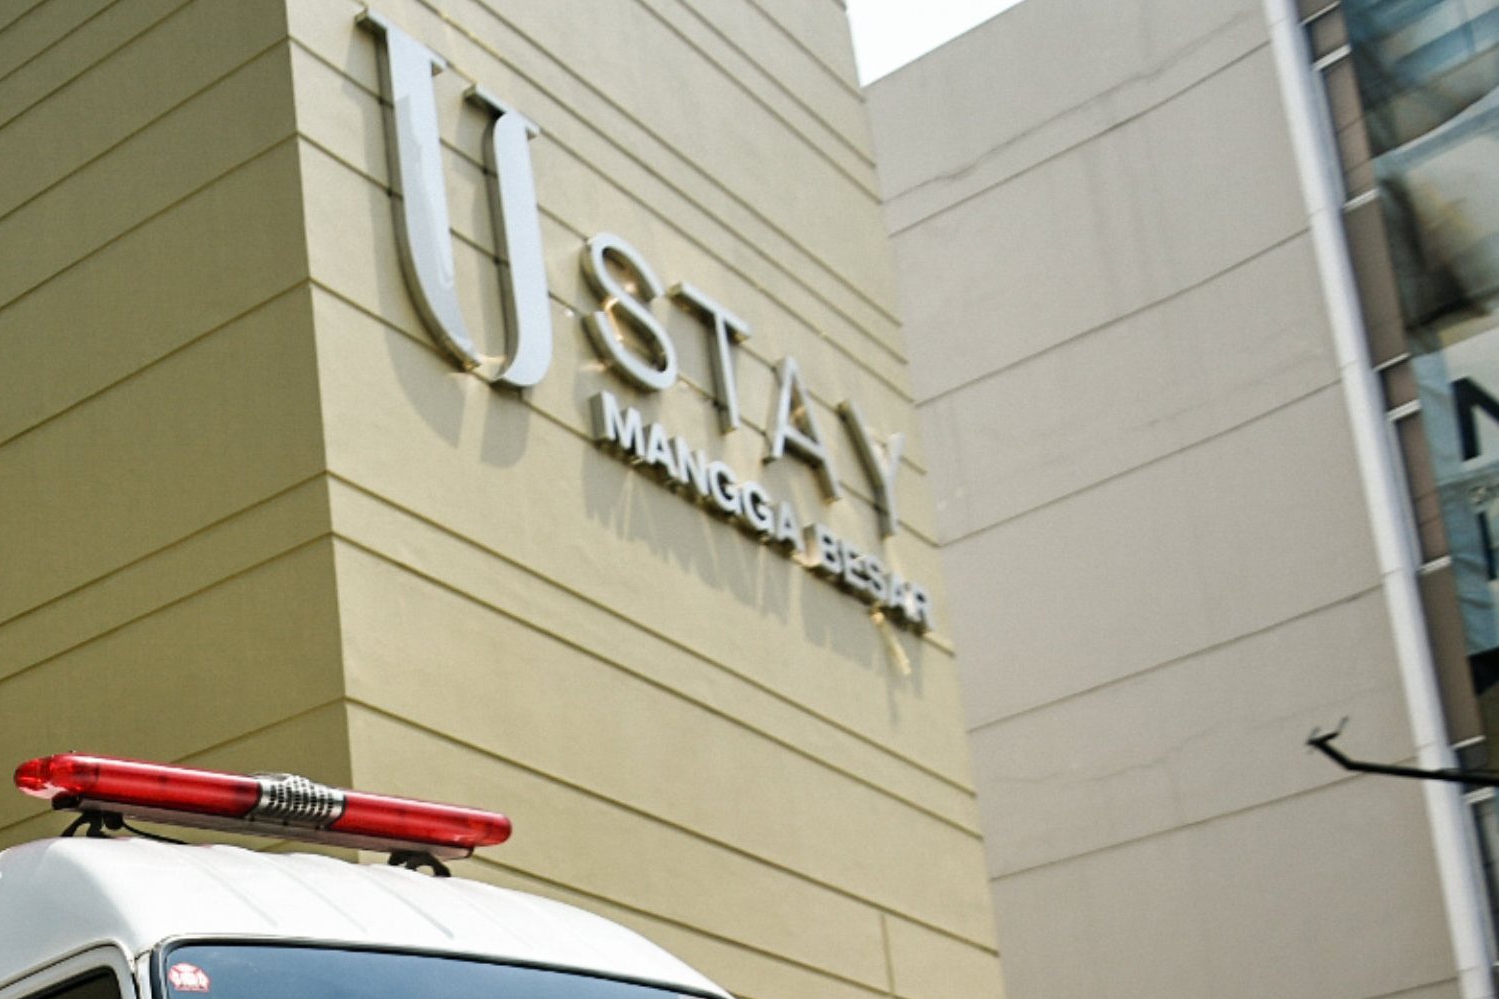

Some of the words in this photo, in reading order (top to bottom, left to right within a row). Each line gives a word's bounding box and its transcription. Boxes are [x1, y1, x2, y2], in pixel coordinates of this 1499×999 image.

[356, 8, 551, 387] U
[582, 232, 903, 537] STAY
[593, 390, 806, 556] MANGGA
[805, 520, 932, 634] BESAR
